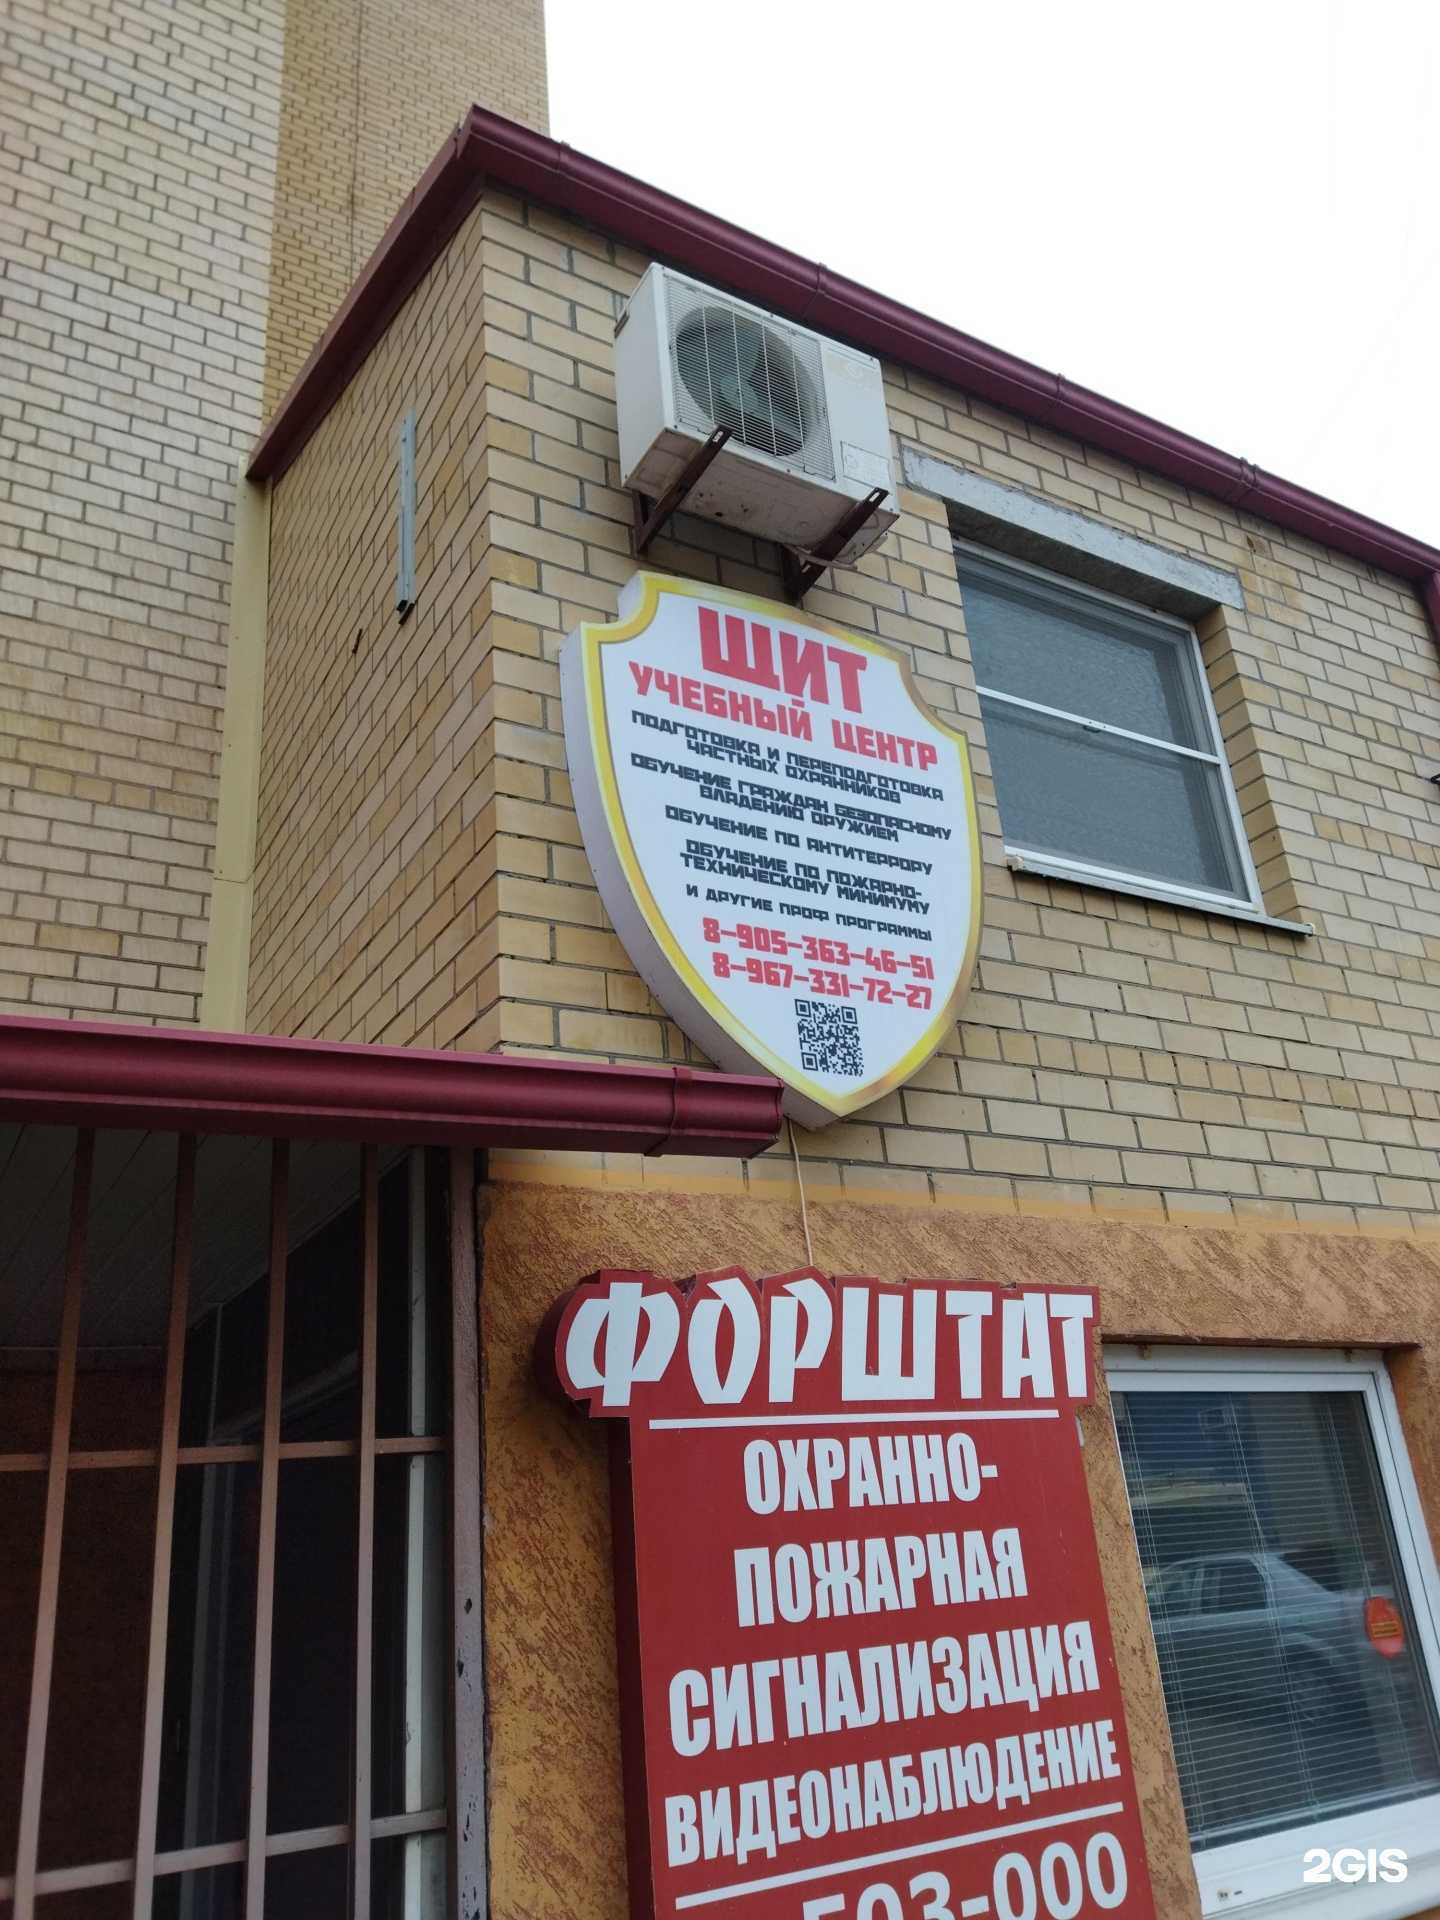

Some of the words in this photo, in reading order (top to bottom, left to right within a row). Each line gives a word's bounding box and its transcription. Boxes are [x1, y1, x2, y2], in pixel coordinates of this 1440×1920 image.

[698, 606, 867, 713] ЩИТ
[628, 661, 813, 742] УЧЕБНЫЙ
[832, 719, 938, 771] ЦЕНТР
[632, 710, 760, 756] ПОДГОТОВКА
[767, 746, 780, 762] И
[786, 751, 944, 801] ПЕРЕПОДГОТОВКА
[631, 752, 732, 790] ОБУЧЕНИЕ
[738, 780, 828, 813] ГРАЖДАН
[834, 803, 951, 840] БЕЗОПАСНОМУ
[687, 739, 778, 775] ЧАСТНЫХ
[785, 764, 901, 804] ОХРАННИКОВ
[665, 804, 768, 840] ОБУЧЕНИЕ
[774, 830, 800, 848] ПО
[806, 837, 932, 875] АНТИТЕРРОРУ
[699, 784, 804, 821] ВЛАДЕНИЮ
[811, 811, 899, 842] ОРУЖИЕМ
[680, 852, 829, 895] ТЕХНИЧЕСКОМУ
[836, 885, 930, 915] МИНИМУМУ
[686, 839, 788, 873] ОБУЧЕНИЕ
[795, 862, 820, 880] ПО
[826, 869, 922, 899] ПОЖАРНО-
[686, 883, 698, 898] И
[706, 888, 773, 912] ДРУГИЕ
[779, 902, 829, 922] ПРОФ
[836, 913, 932, 941] ПРОГРАММЫ
[703, 917, 934, 980] 8-905-363-46-51
[712, 952, 932, 1010] 8-967-331-72-27
[565, 1277, 1093, 1406] ФОРШТАТ
[743, 1433, 998, 1515] ОХРАННО-
[733, 1527, 1028, 1627] ПОЖАРНАЯ
[668, 1620, 1100, 1757] СИГНАЛИЗАЦИЯ
[664, 1720, 1121, 1868] ВИДЕОНАБЛЮДЕНИЕ
